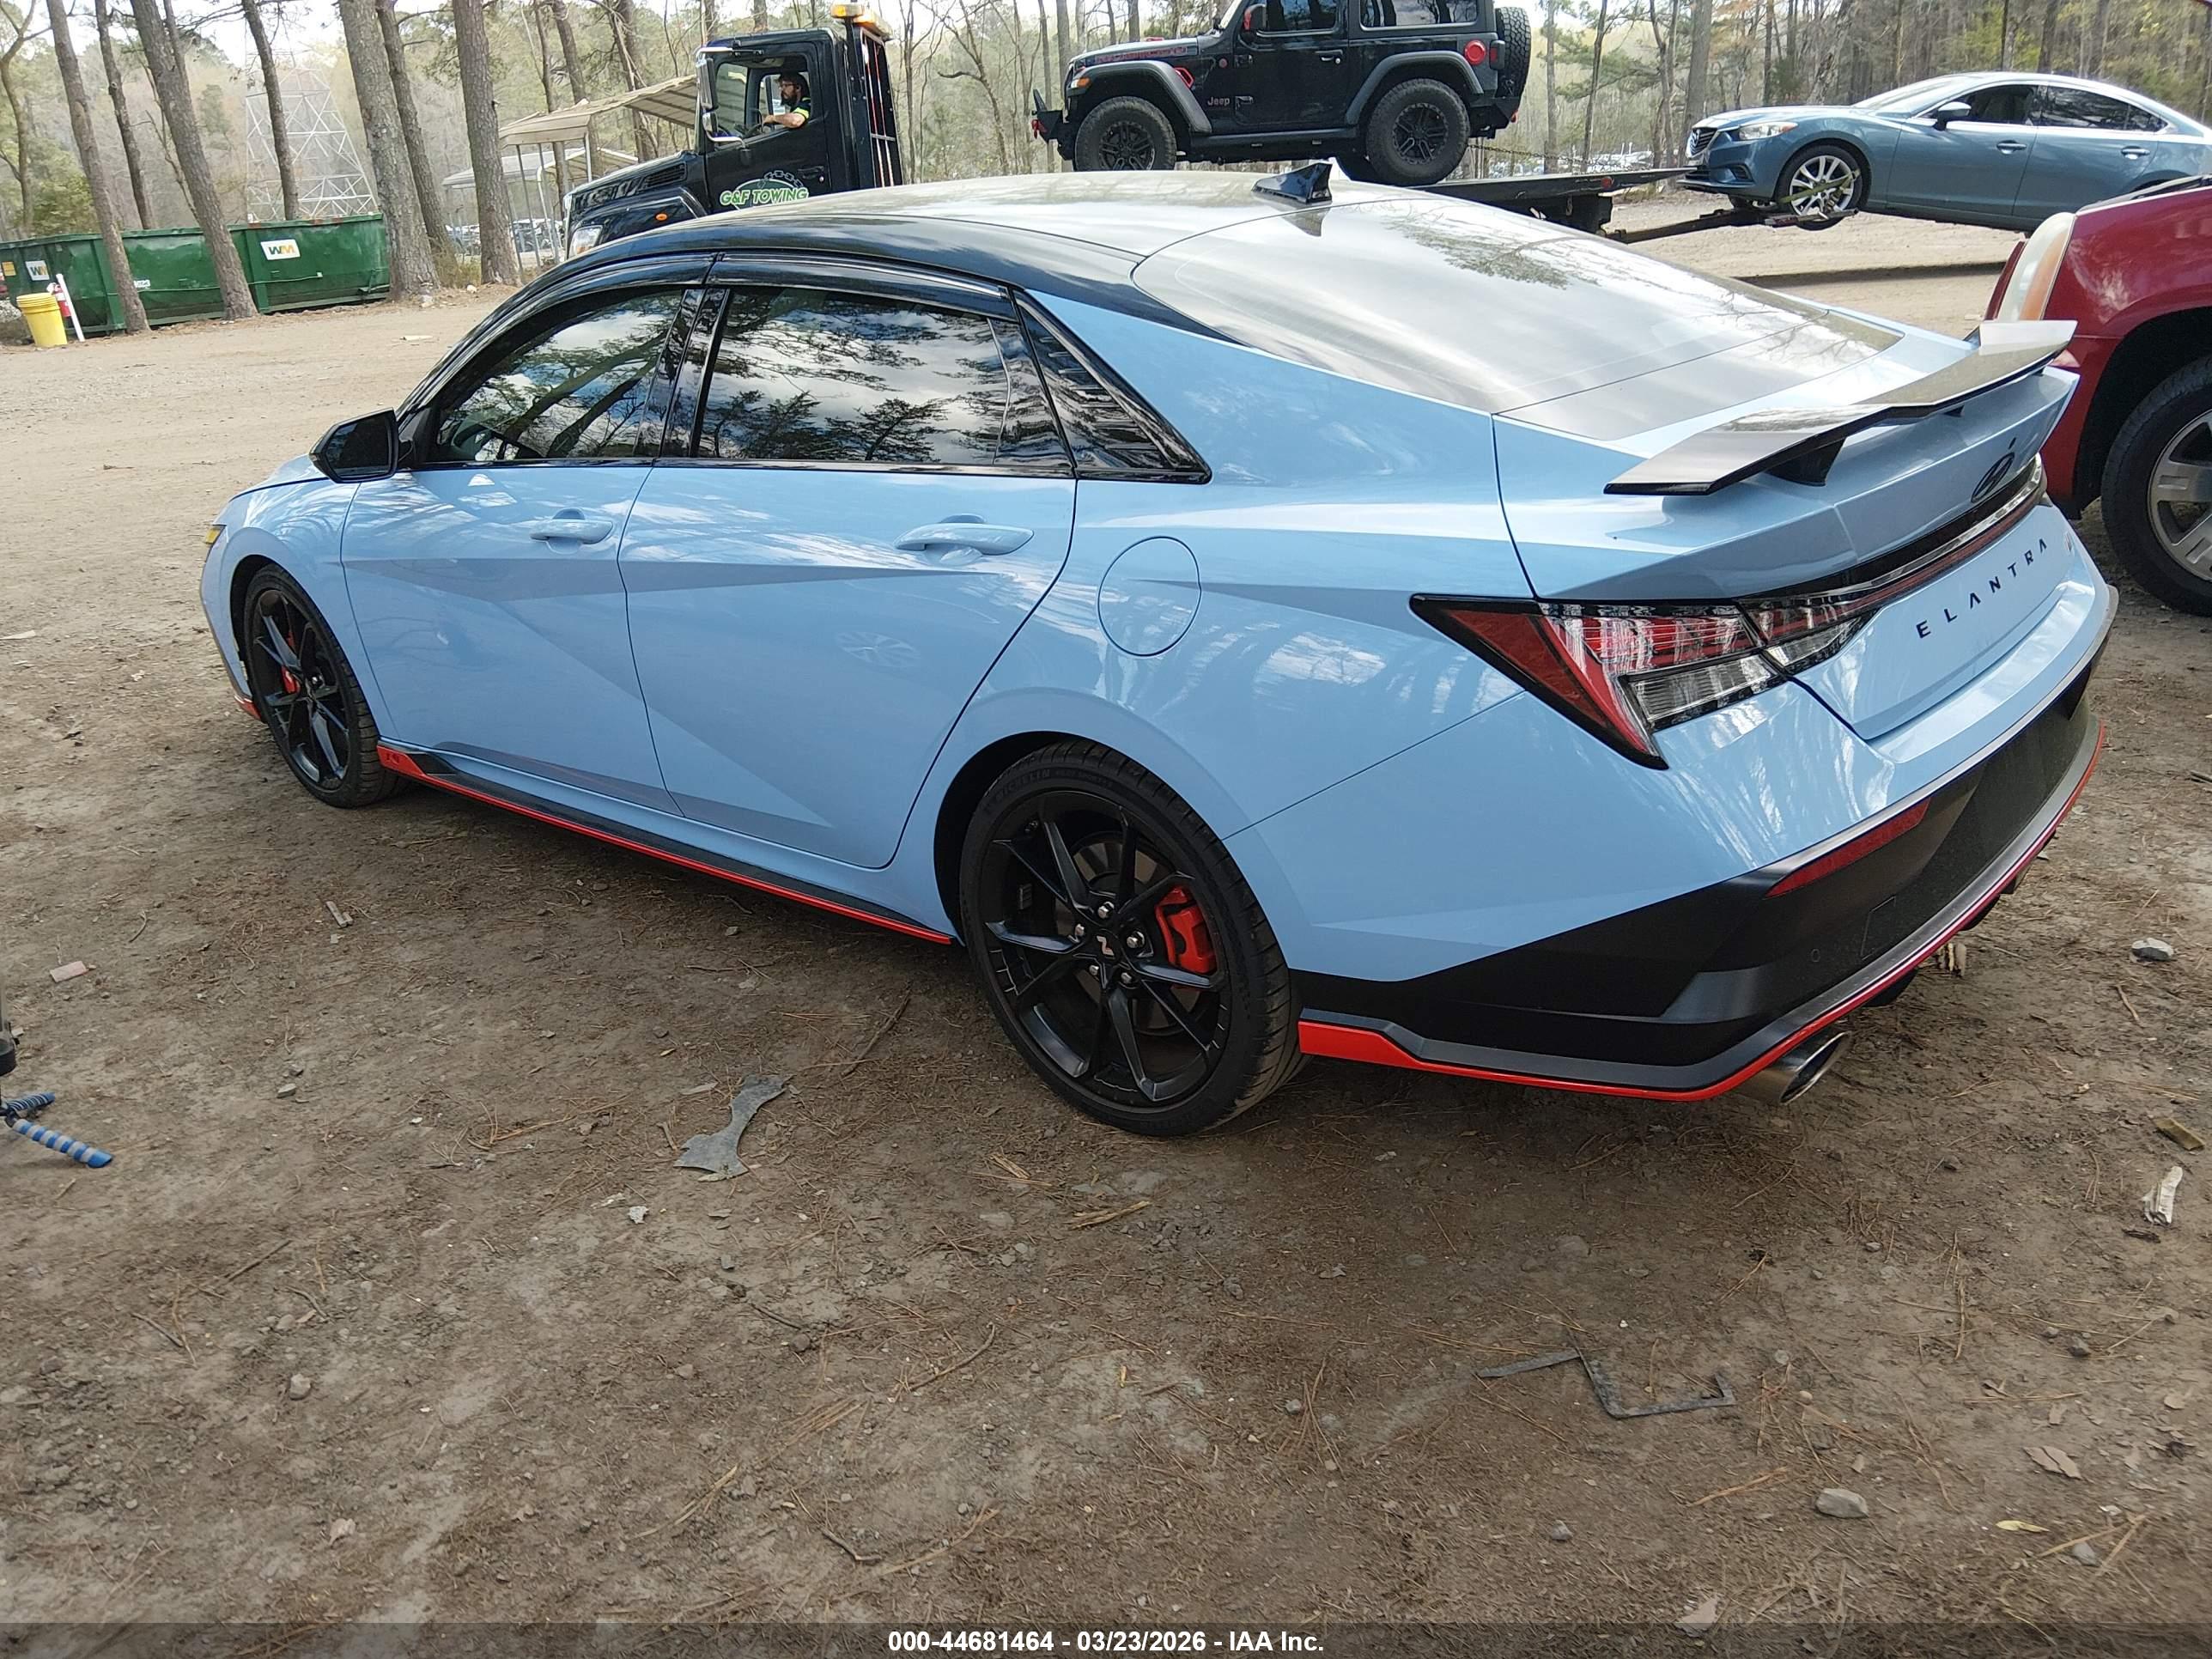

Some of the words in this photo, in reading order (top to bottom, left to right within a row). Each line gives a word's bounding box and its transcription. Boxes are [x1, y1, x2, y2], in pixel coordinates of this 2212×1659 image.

[1207, 96, 1231, 106] Jeep
[720, 190, 750, 206] G&F
[752, 187, 810, 204] TOWING
[268, 244, 295, 255] WM
[30, 265, 48, 276] WM
[1916, 538, 2048, 639] ELANTRA
